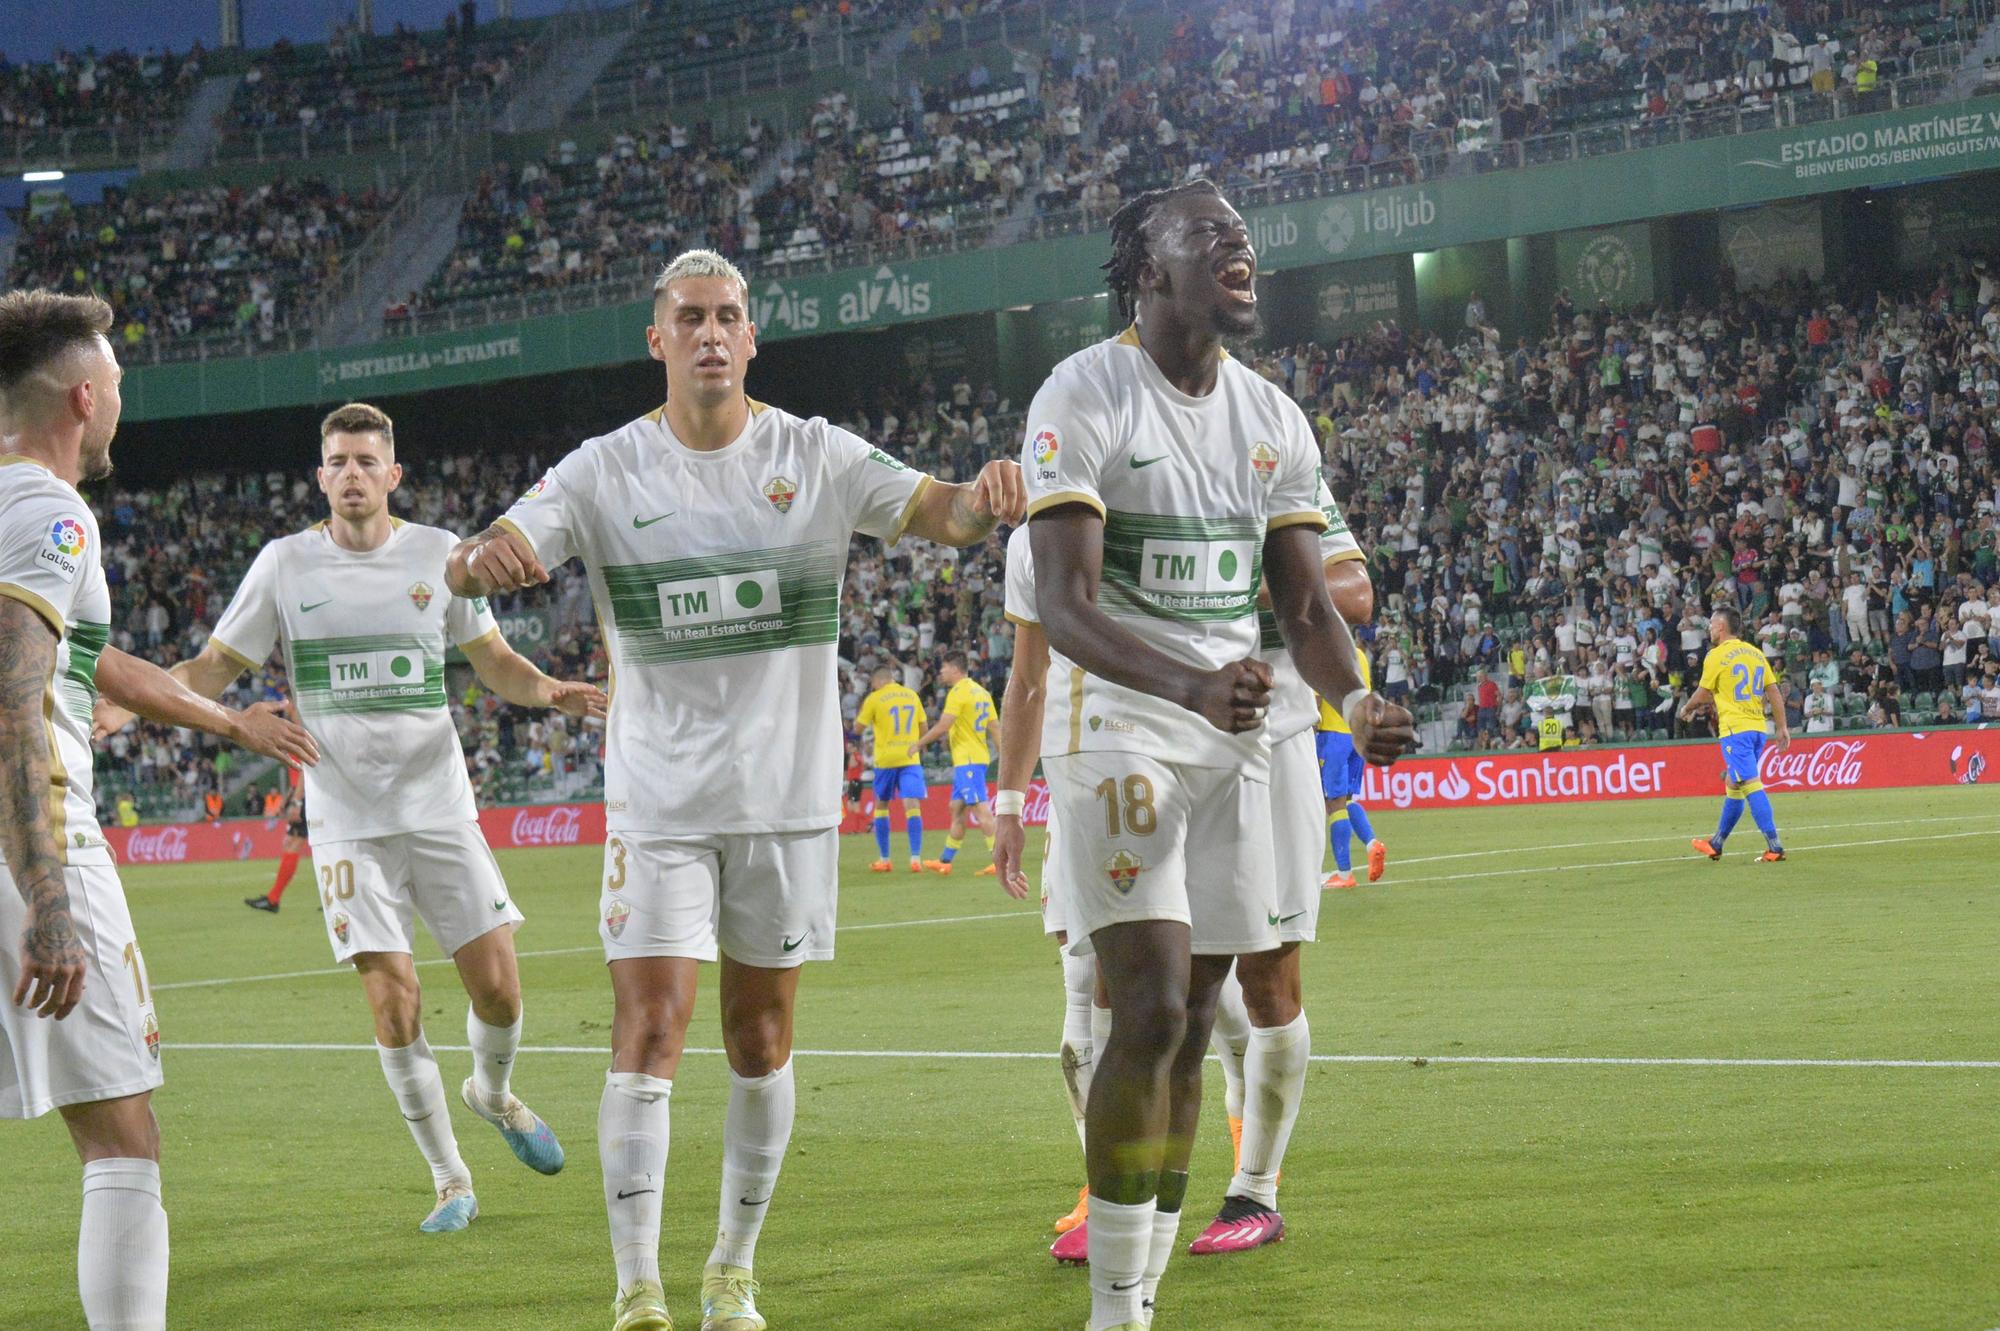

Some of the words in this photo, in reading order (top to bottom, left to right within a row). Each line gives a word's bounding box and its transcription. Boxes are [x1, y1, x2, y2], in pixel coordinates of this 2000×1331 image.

[1781, 131, 1868, 162] ESTADIO
[1874, 113, 1984, 148] MARTÍNEZ
[339, 352, 431, 381] ESTRELLA
[443, 337, 520, 365] LEVANTE
[41, 548, 75, 574] LaLiga
[1152, 553, 1196, 581] TM
[667, 590, 709, 617] TM
[1164, 595, 1190, 608] Real
[1193, 597, 1223, 608] Estate
[663, 630, 681, 641] TM
[684, 626, 709, 640] Real
[711, 621, 746, 637] Estate
[749, 618, 784, 632] Group
[336, 661, 369, 681] TM
[1732, 663, 1766, 702] 24
[349, 689, 368, 700] Real
[370, 686, 397, 699] Estate
[400, 685, 426, 697] Group
[889, 705, 915, 736] 17
[1104, 719, 1136, 732] ELCHE
[1545, 723, 1557, 735] 20
[1353, 764, 1435, 808] Liga
[1474, 754, 1666, 800] Santander
[1096, 772, 1158, 838] 18
[607, 837, 627, 892] 3
[320, 859, 356, 909] 20
[122, 942, 152, 1008] 1
